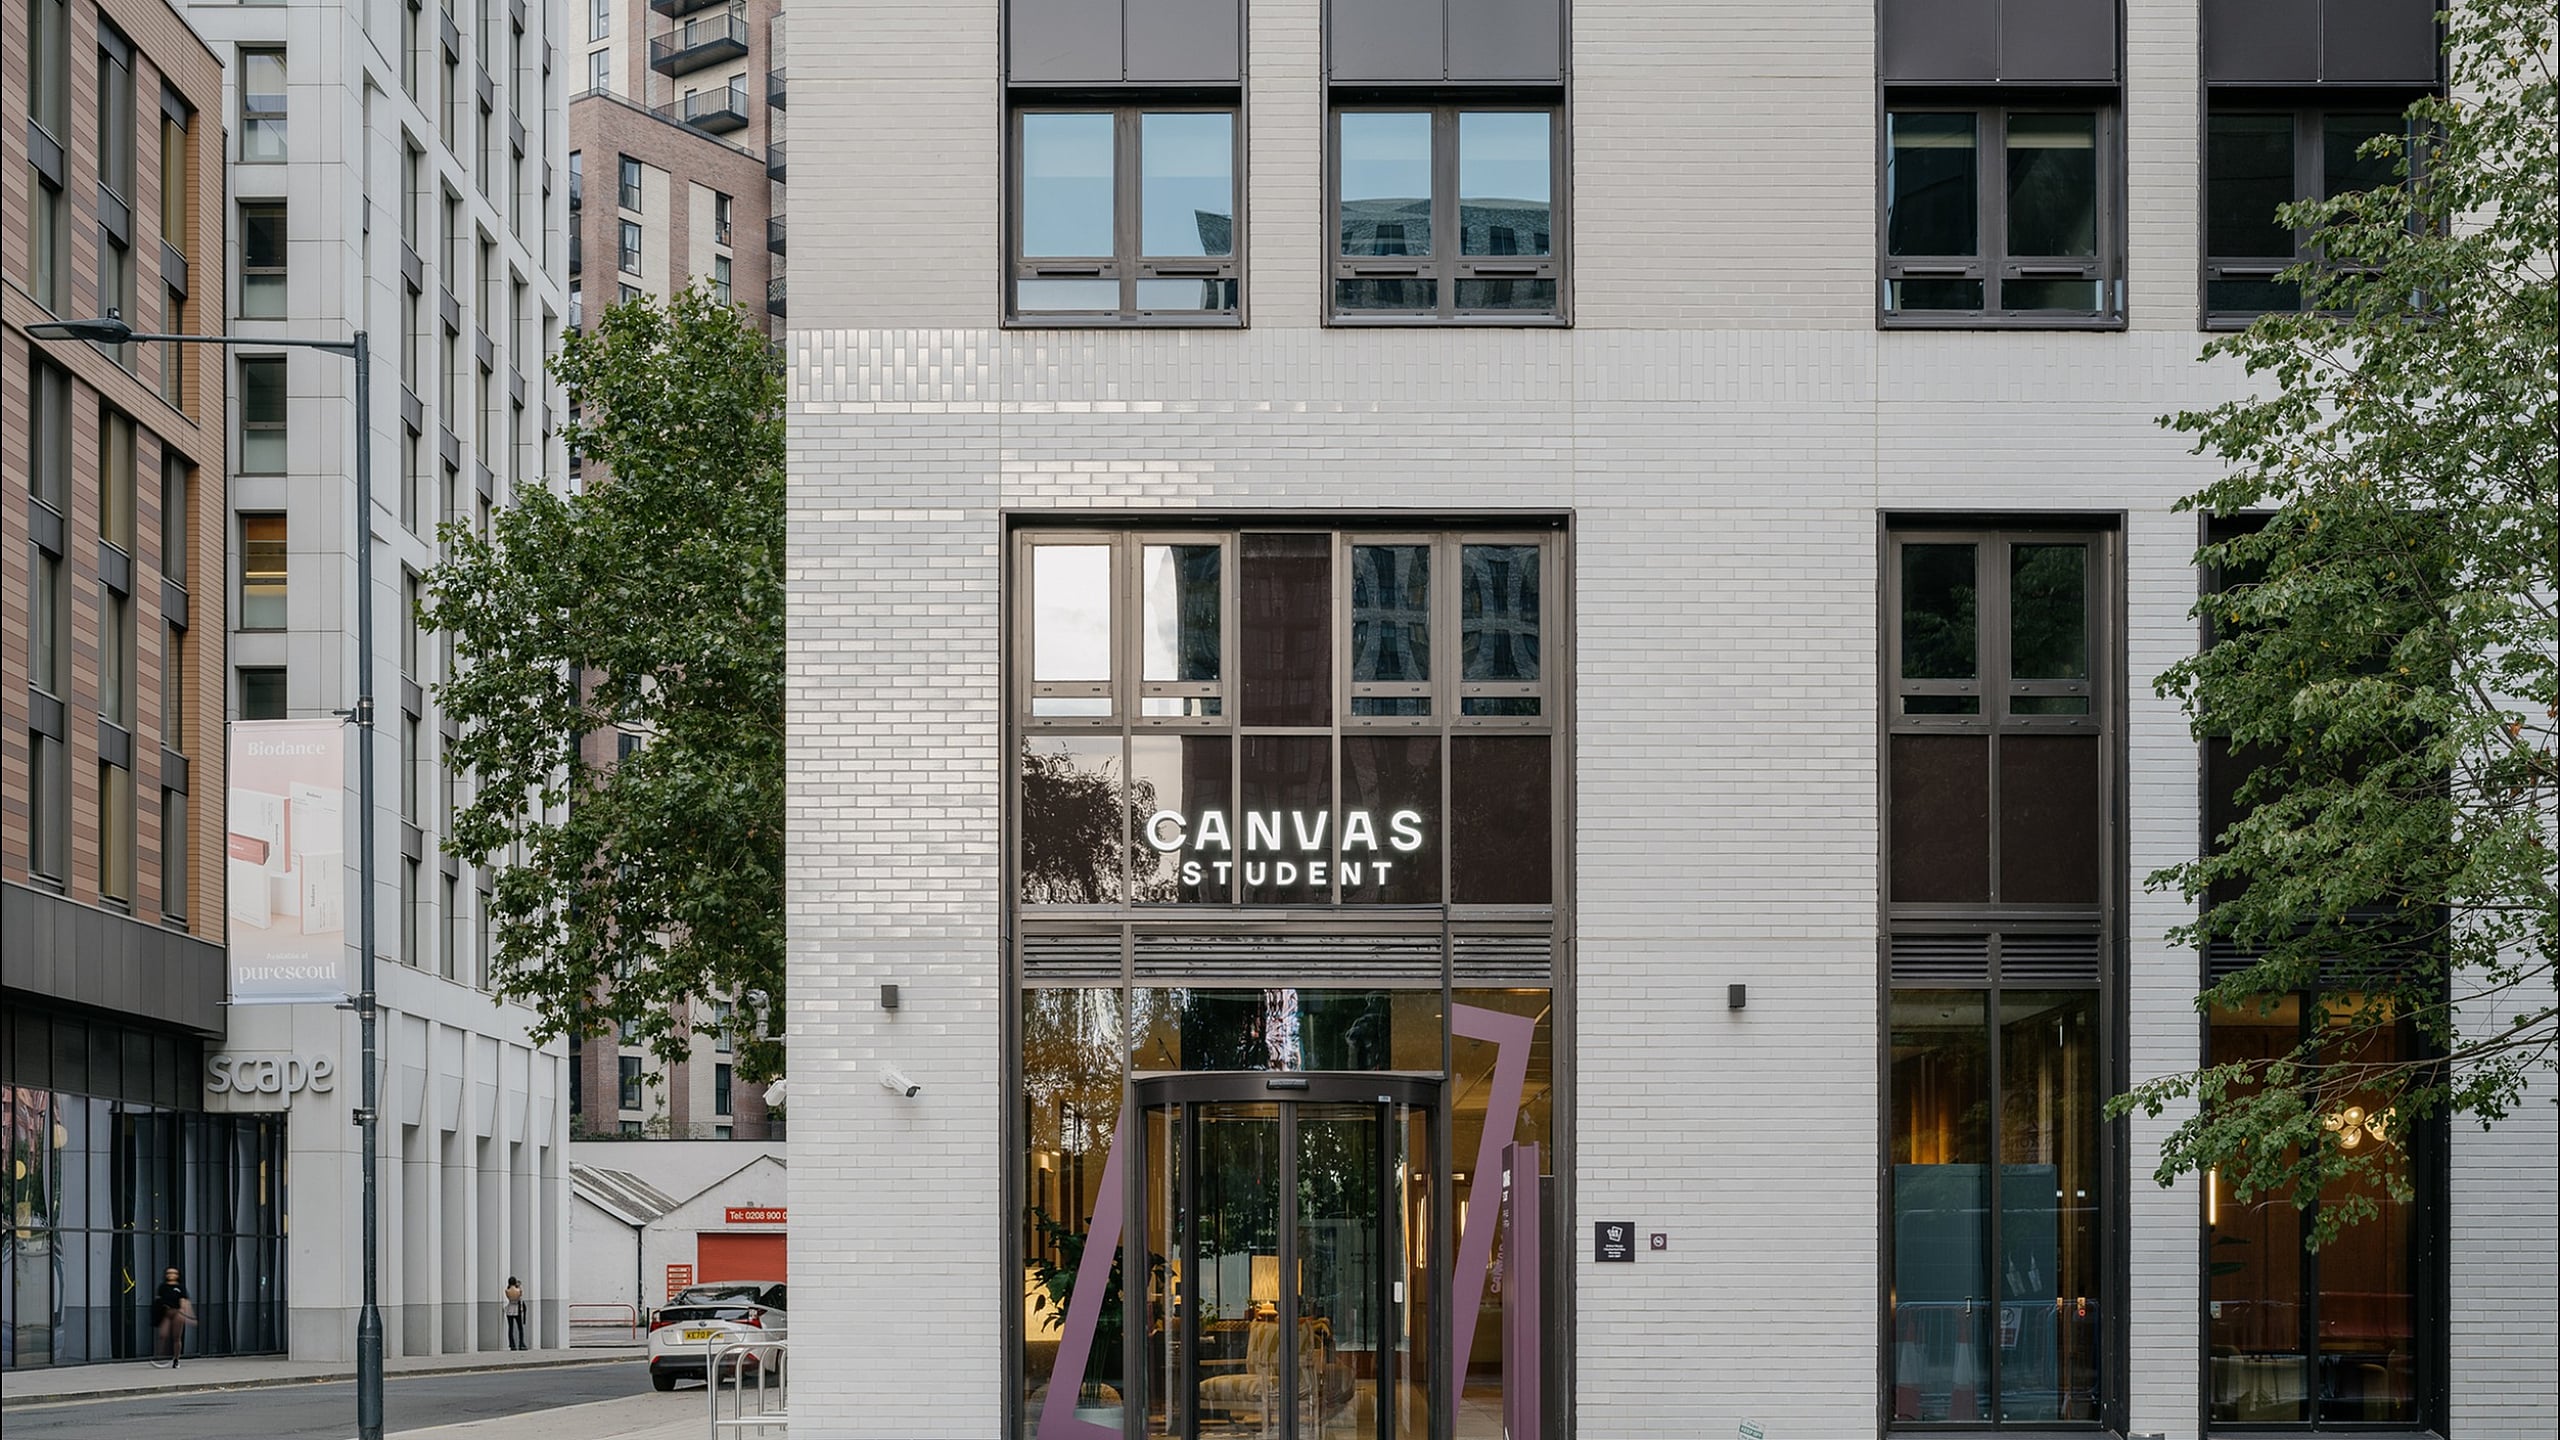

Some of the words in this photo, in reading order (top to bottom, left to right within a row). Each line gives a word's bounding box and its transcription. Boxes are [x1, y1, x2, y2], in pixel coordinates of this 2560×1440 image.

[247, 741, 326, 756] Biodance
[1146, 810, 1423, 851] CANVAS
[1182, 861, 1392, 886] STUDENT
[239, 961, 336, 984] pureseoul
[207, 1055, 334, 1110] scape
[730, 1211, 744, 1220] Tel:
[745, 1211, 765, 1220] 0208
[766, 1211, 781, 1220] 900
